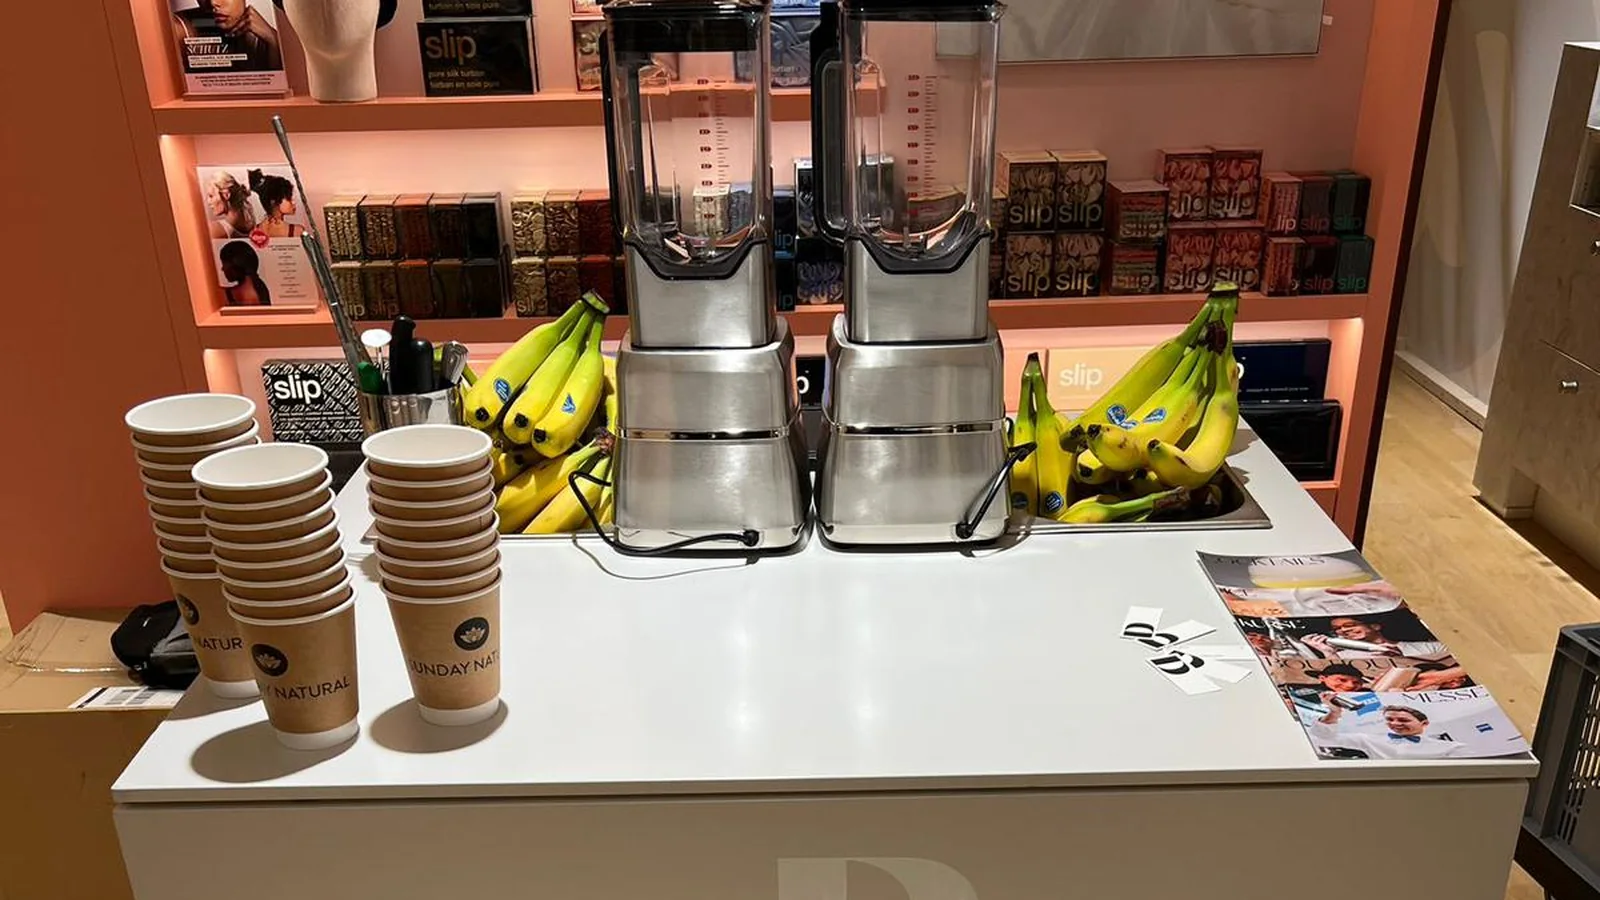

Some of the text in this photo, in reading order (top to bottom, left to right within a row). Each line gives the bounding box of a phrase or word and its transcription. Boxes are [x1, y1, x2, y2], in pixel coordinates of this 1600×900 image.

[425, 28, 477, 65] slip
[1008, 202, 1053, 229] slip
[1058, 201, 1102, 229] slip
[1275, 215, 1297, 235] lip
[1301, 214, 1331, 234] slip
[774, 229, 793, 249] lip
[1007, 269, 1050, 297] slip
[1056, 267, 1100, 296] slip
[1304, 272, 1335, 293] slip
[1338, 273, 1367, 292] slip
[344, 302, 365, 319] lip
[274, 374, 321, 405] slip
[1060, 363, 1103, 391] slip
[275, 676, 350, 699] NATURAL
